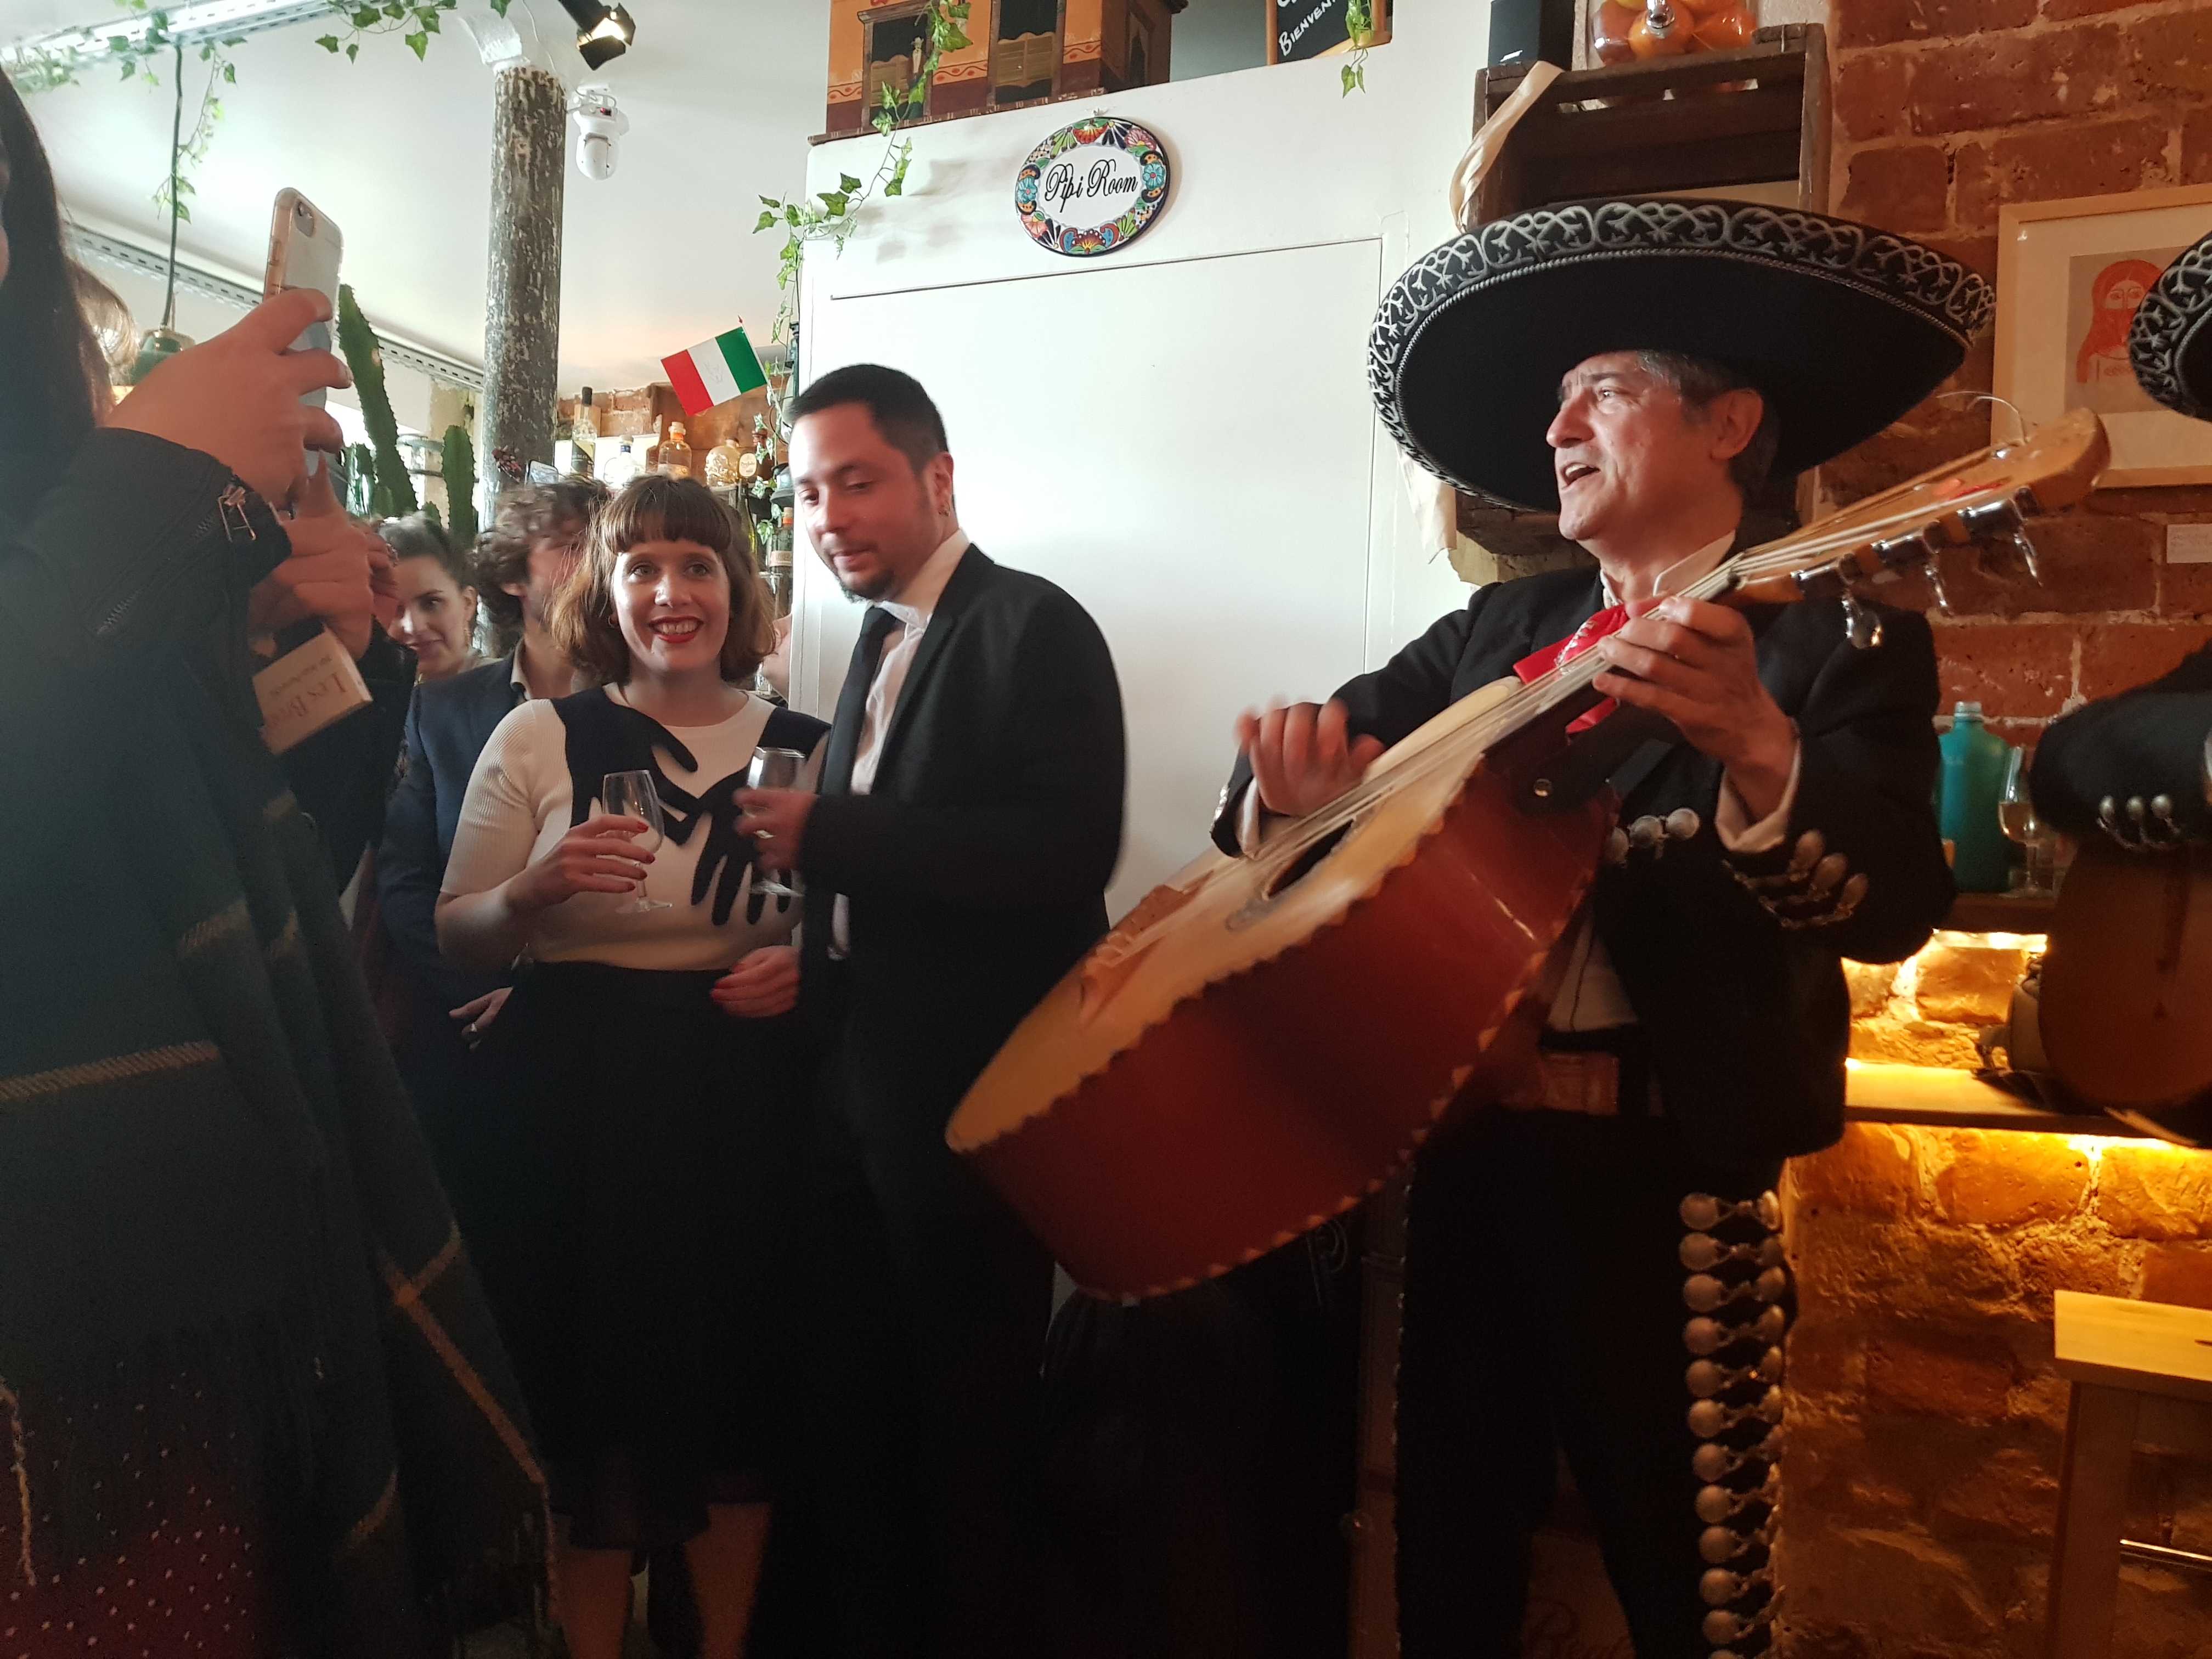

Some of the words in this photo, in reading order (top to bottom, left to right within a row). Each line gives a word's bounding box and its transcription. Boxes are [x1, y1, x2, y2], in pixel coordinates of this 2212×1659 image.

[1278, 0, 1336, 56] BIENVEN
[1045, 163, 1084, 213] Pipi
[1087, 159, 1139, 198] Room
